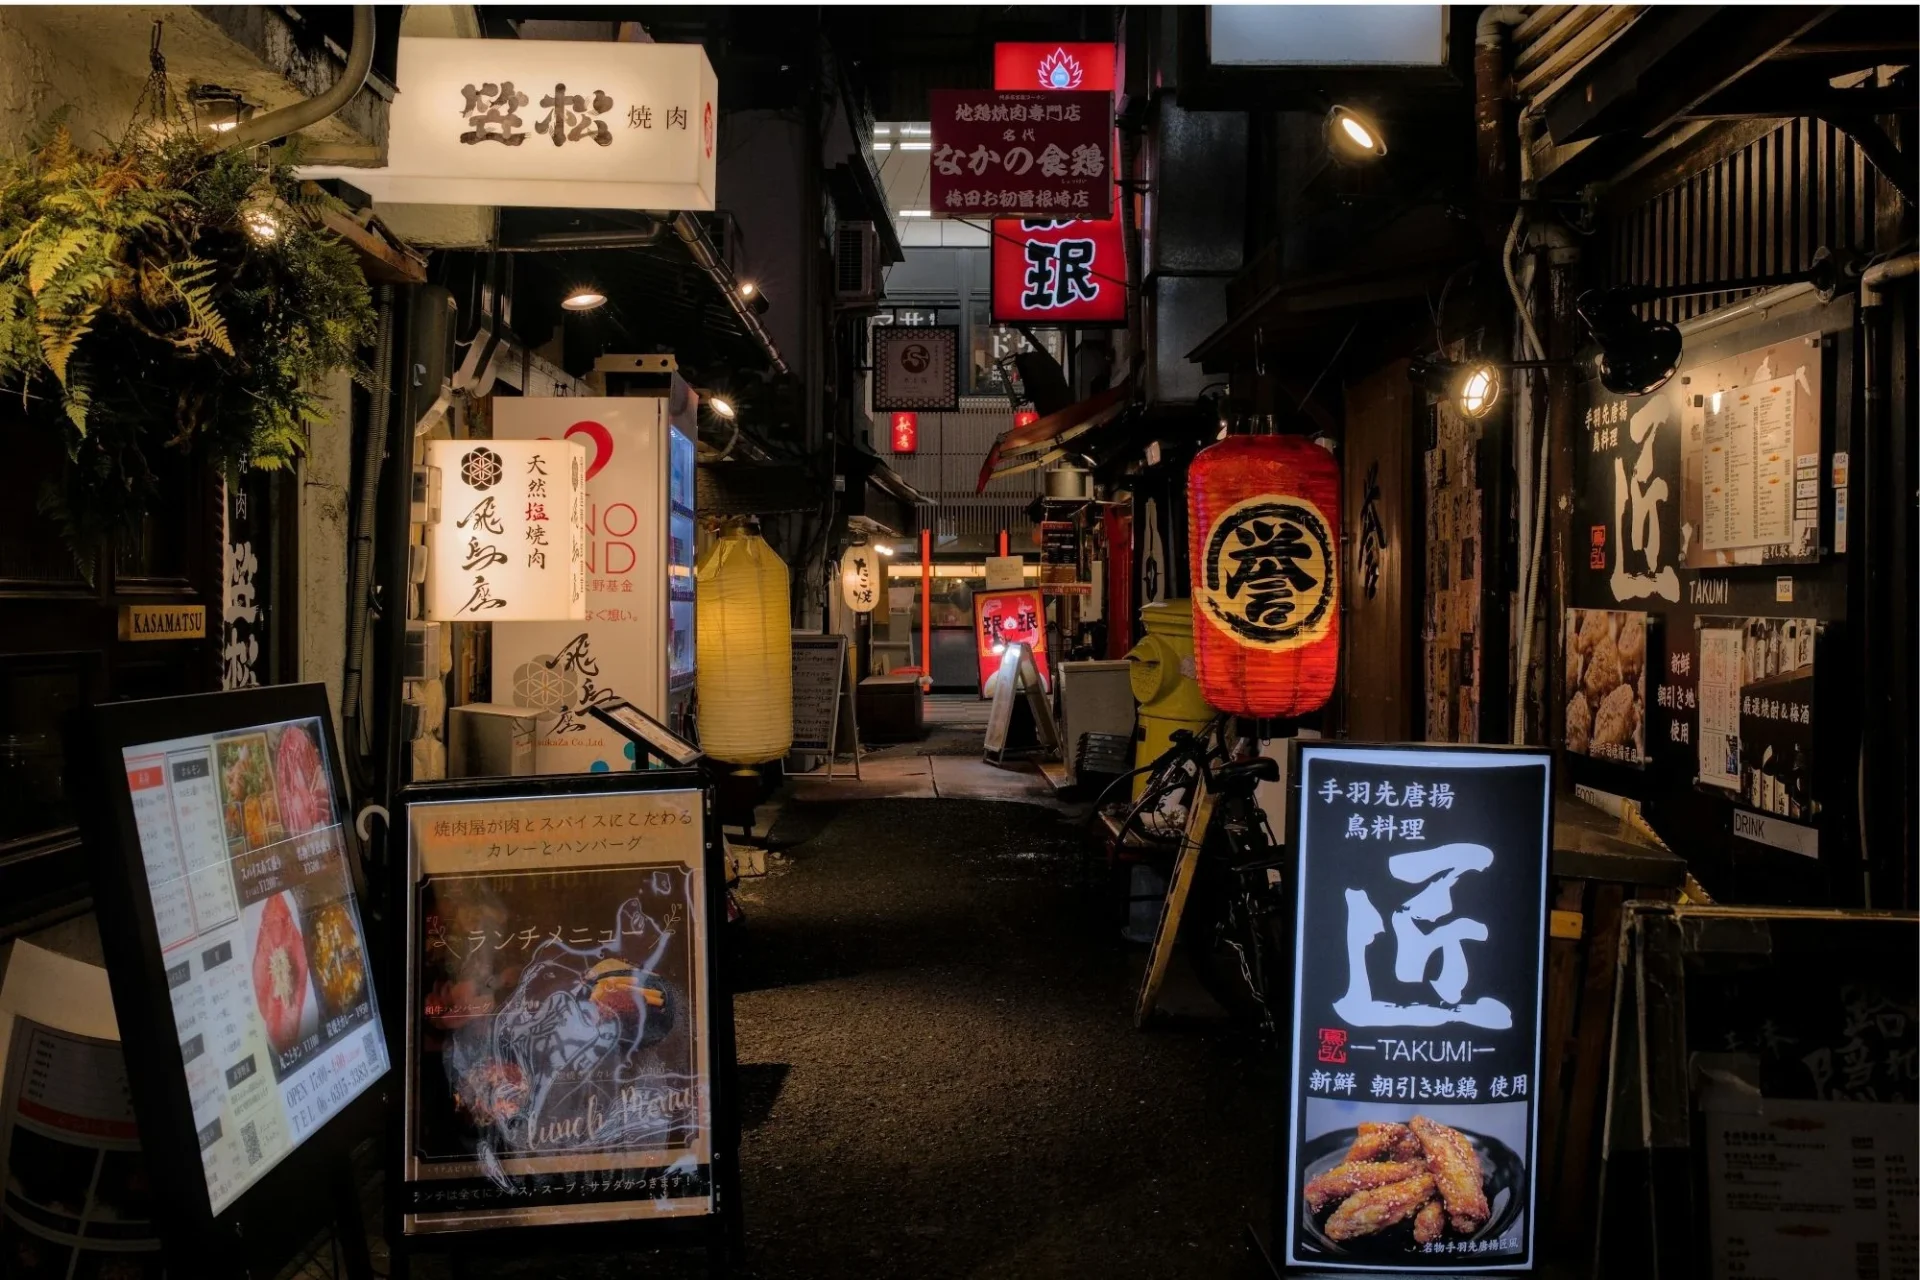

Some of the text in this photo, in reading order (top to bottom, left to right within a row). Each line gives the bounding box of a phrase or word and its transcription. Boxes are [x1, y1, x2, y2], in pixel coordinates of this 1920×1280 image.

[627, 104, 688, 130] 焼肉
[955, 103, 1081, 122] 地鶏焼肉専門店
[1002, 128, 1036, 142] 名代
[932, 143, 1105, 178] なかの食鶏
[1021, 219, 1099, 310] 珉
[1584, 399, 1628, 431] 手羽先唐揚
[524, 454, 550, 570] 天然塩焼肉
[1610, 395, 1680, 603] 匠
[853, 557, 872, 604] たこ焼
[1689, 578, 1729, 605] TAKUMI
[133, 612, 203, 634] KASAMATSU
[1670, 651, 1691, 677] 新鮮
[1670, 719, 1690, 745] 使用
[1317, 778, 1456, 810] 手羽先唐揚
[434, 809, 692, 838] 焼肉屋が肉とスパイスにこだわる
[1344, 814, 1427, 842] 鳥料理
[1734, 814, 1765, 839] DRINK
[488, 835, 643, 858] カレーとハンバーグ
[468, 925, 644, 953] ランチメニュー
[1332, 842, 1513, 1030] 匠
[287, 1082, 309, 1109] OPEN
[1309, 1069, 1528, 1100] 新鮮 朝引き地鶏 使用
[293, 1104, 316, 1134] TEL
[1422, 1236, 1519, 1253] 名物手羽先唐揚匠風
